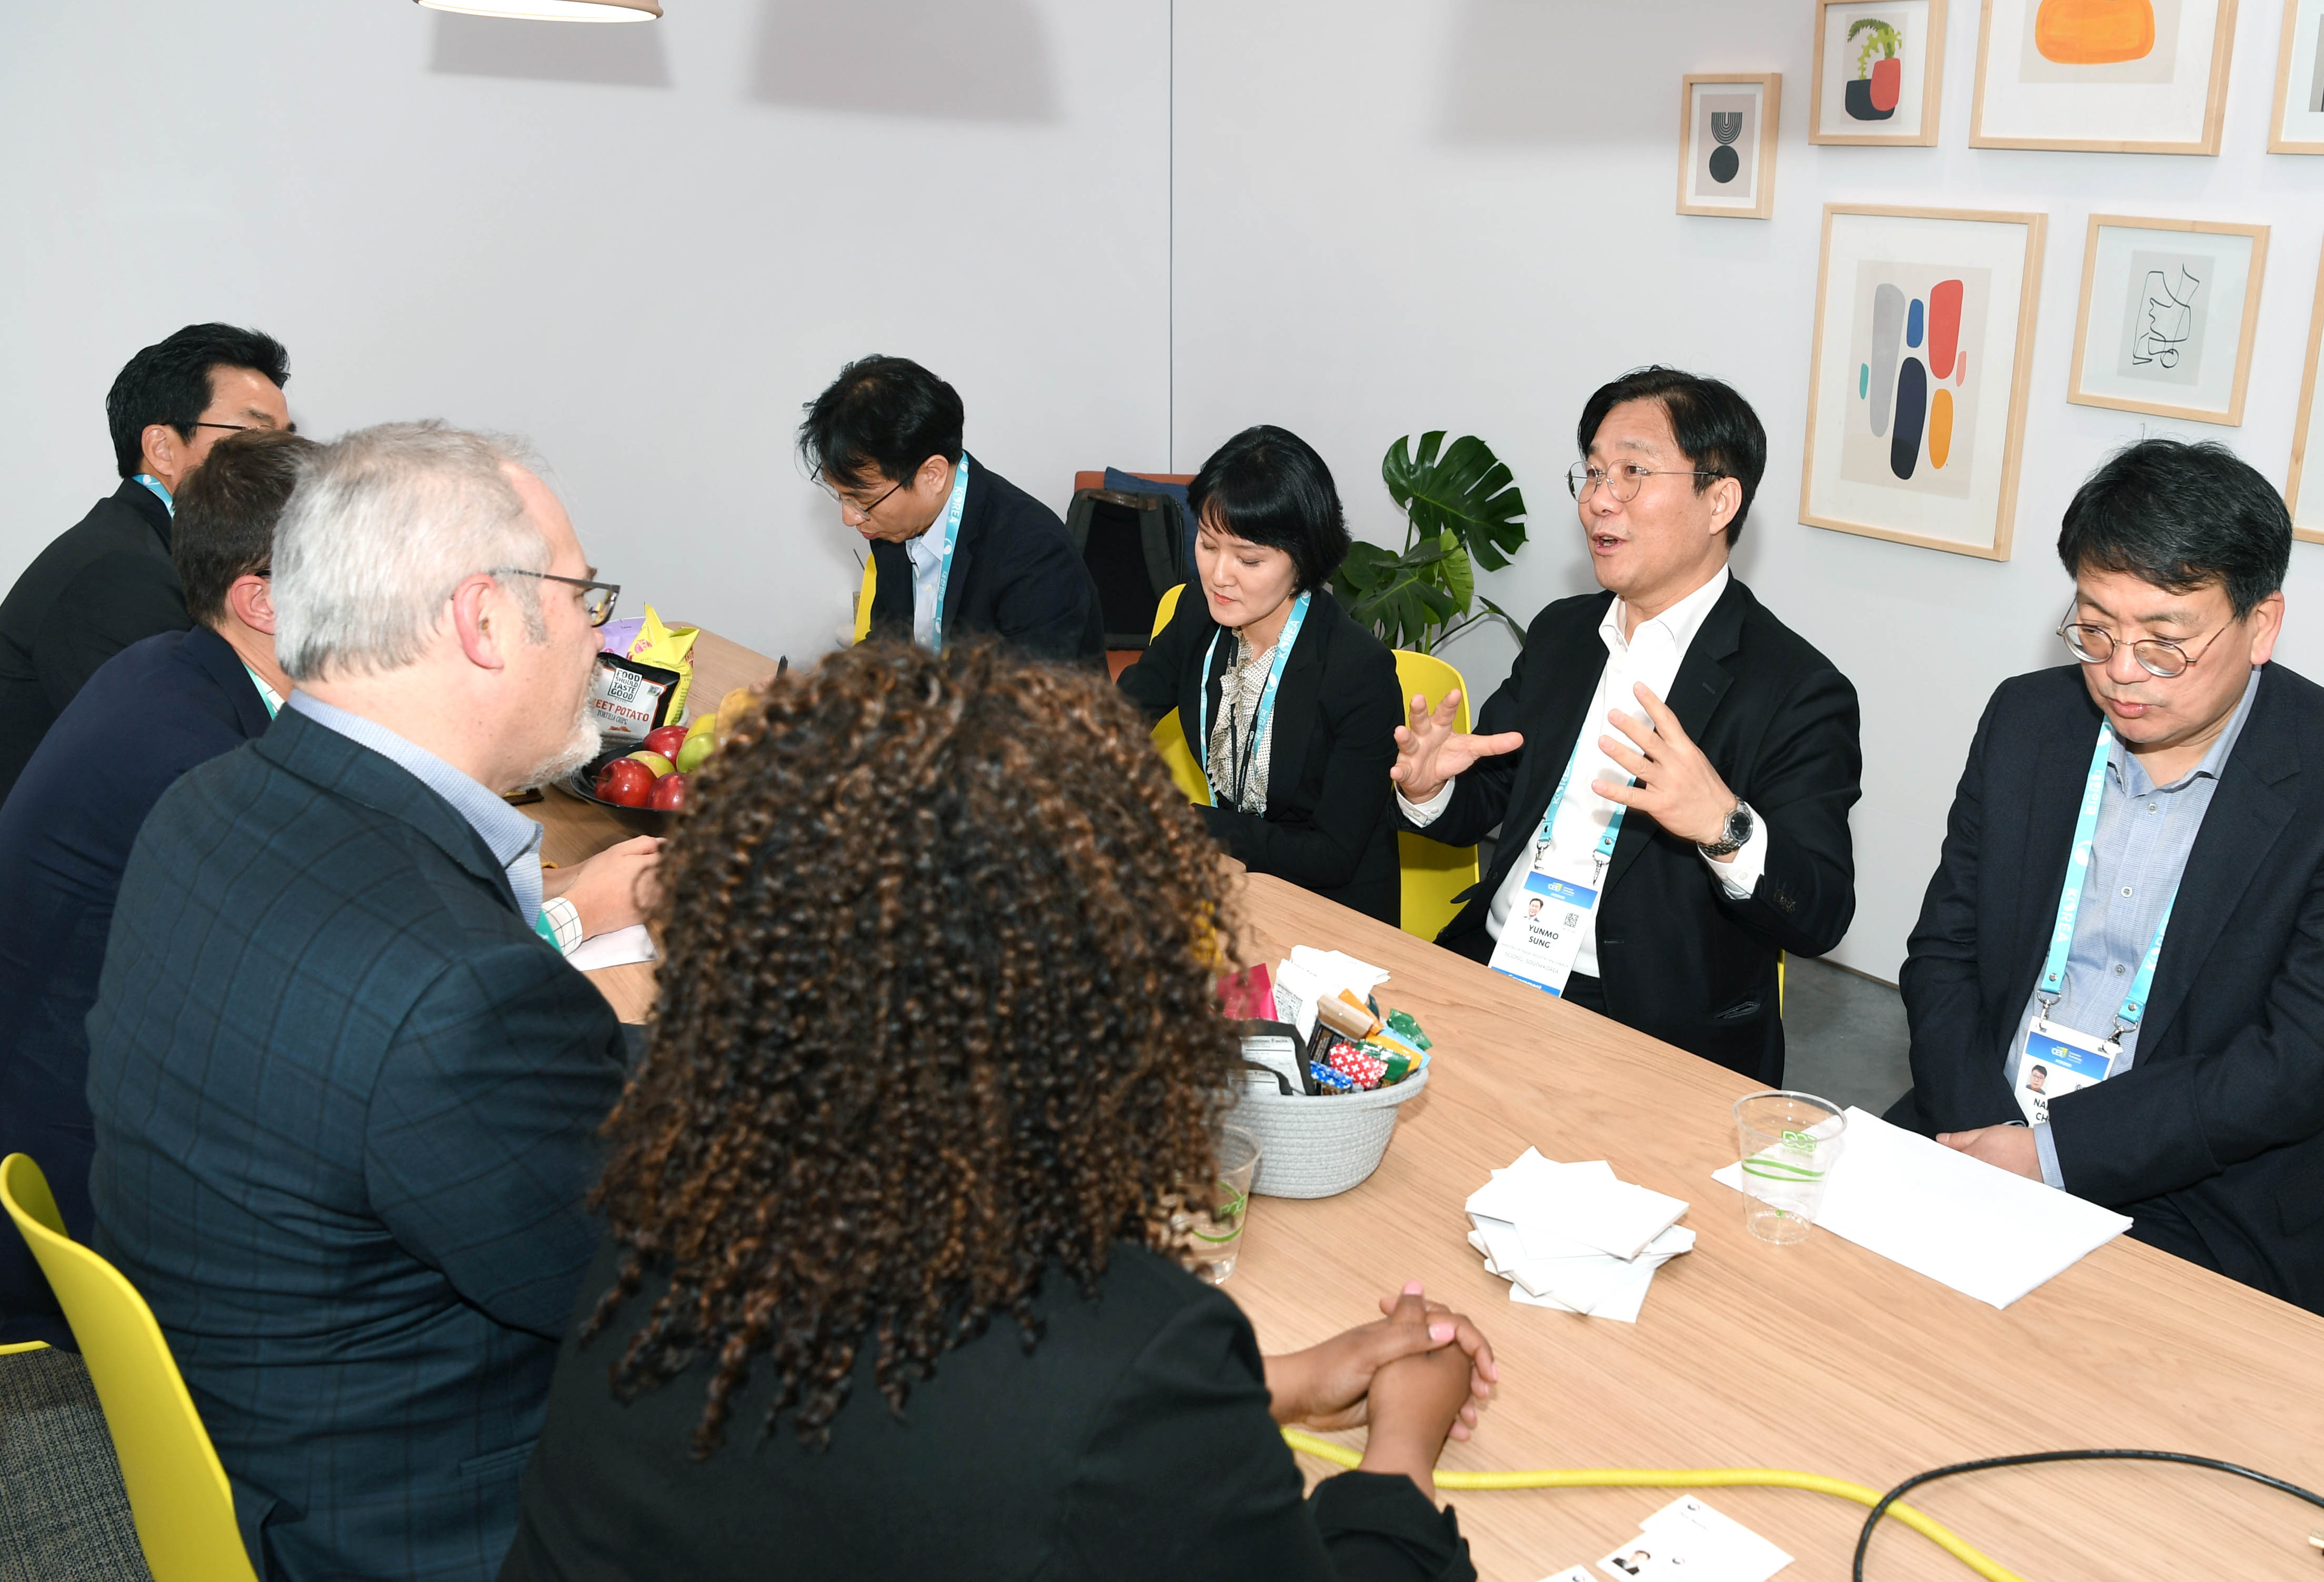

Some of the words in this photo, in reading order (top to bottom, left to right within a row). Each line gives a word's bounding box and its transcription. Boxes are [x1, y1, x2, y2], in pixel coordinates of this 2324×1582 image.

[949, 486, 964, 523] KOREA
[1277, 620, 1300, 659] KOREA
[615, 676, 639, 688] SHOULD
[617, 670, 640, 682] FOOD
[611, 688, 634, 700] GOOD
[614, 682, 636, 694] TASTE
[594, 699, 615, 712] EET
[614, 705, 650, 722] POTATO
[2083, 769, 2103, 816] 대한민국
[2055, 887, 2081, 943] KOREA
[1528, 924, 1559, 940] YUNMO
[1528, 936, 1550, 948] SUNG
[2051, 1047, 2064, 1058] CES
[2036, 1113, 2050, 1123] CH
